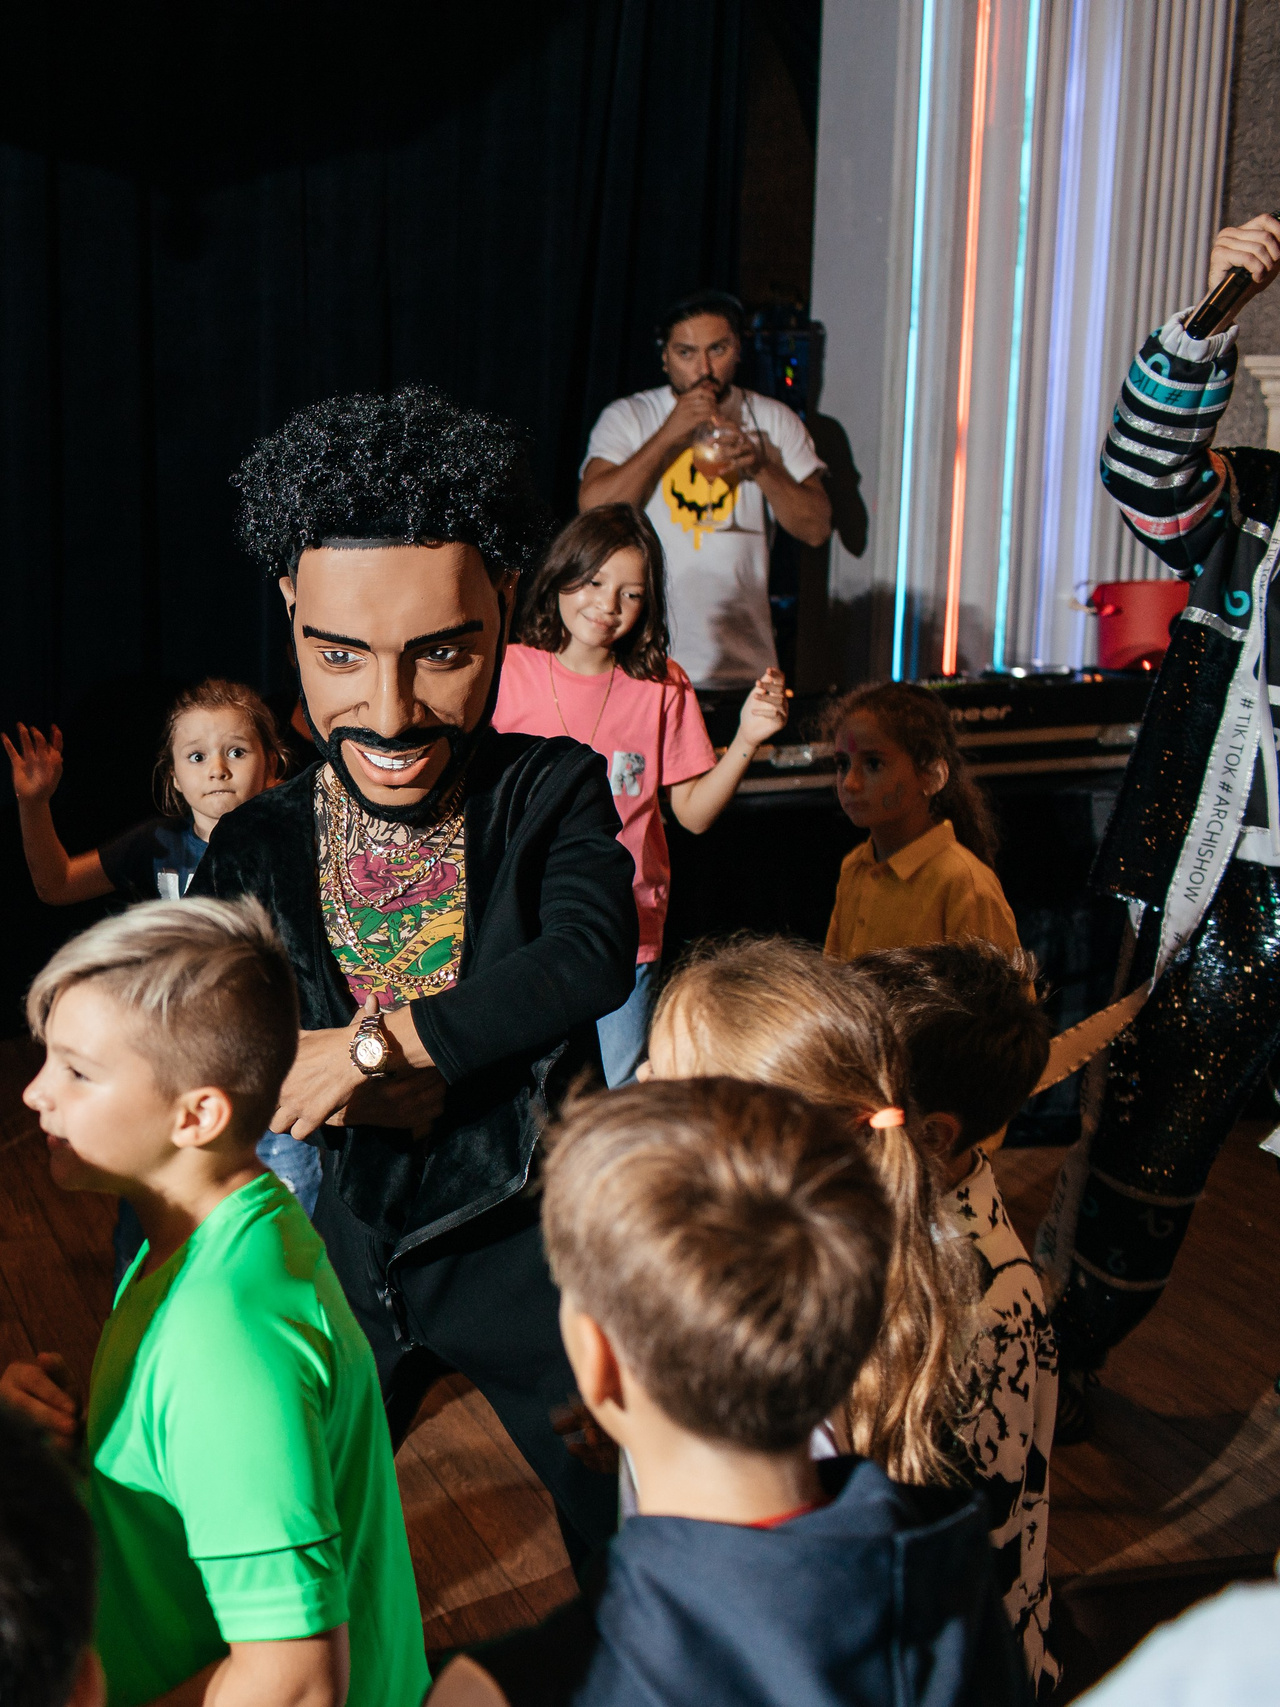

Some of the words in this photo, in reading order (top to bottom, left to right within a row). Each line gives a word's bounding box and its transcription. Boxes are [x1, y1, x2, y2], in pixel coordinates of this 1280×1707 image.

[610, 750, 645, 797] R
[1183, 794, 1231, 904] ARCHISHOW
[388, 935, 431, 973] APPY
